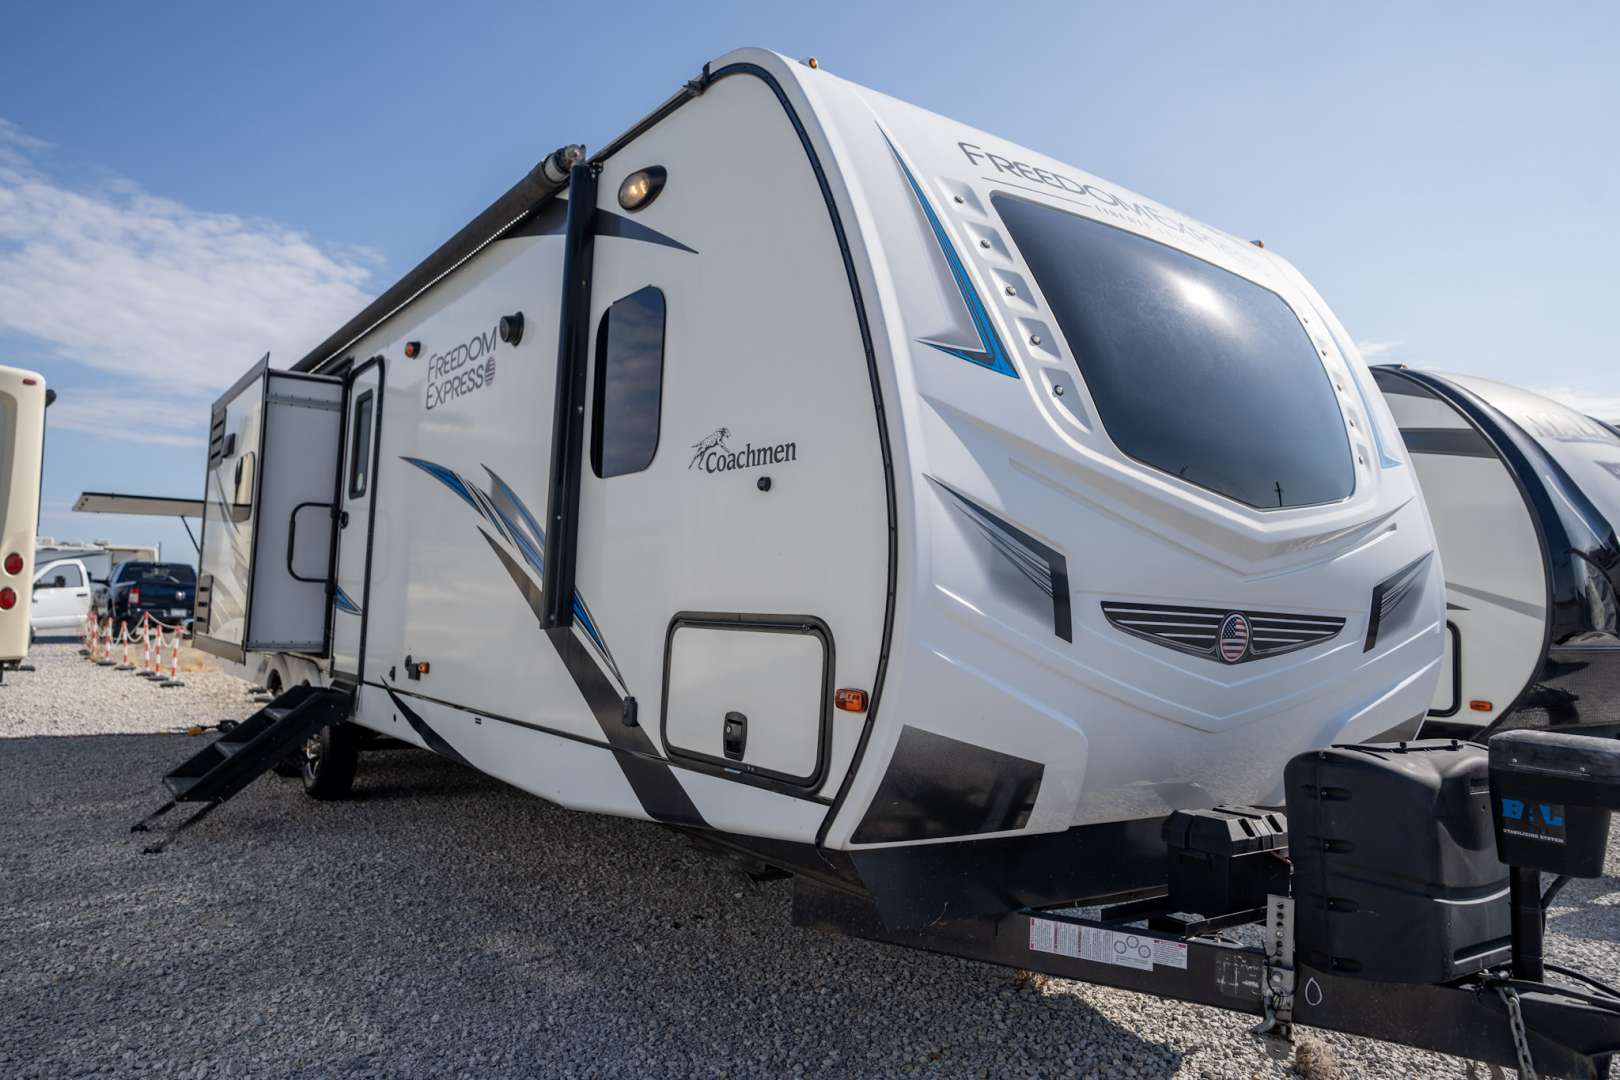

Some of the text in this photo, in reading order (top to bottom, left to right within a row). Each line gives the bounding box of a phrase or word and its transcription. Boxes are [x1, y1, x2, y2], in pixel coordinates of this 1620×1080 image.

[957, 141, 1154, 222] FREEDOM
[427, 326, 497, 382] FREEDOM
[426, 363, 484, 410] EXPRESS
[704, 441, 797, 474] Coachmen
